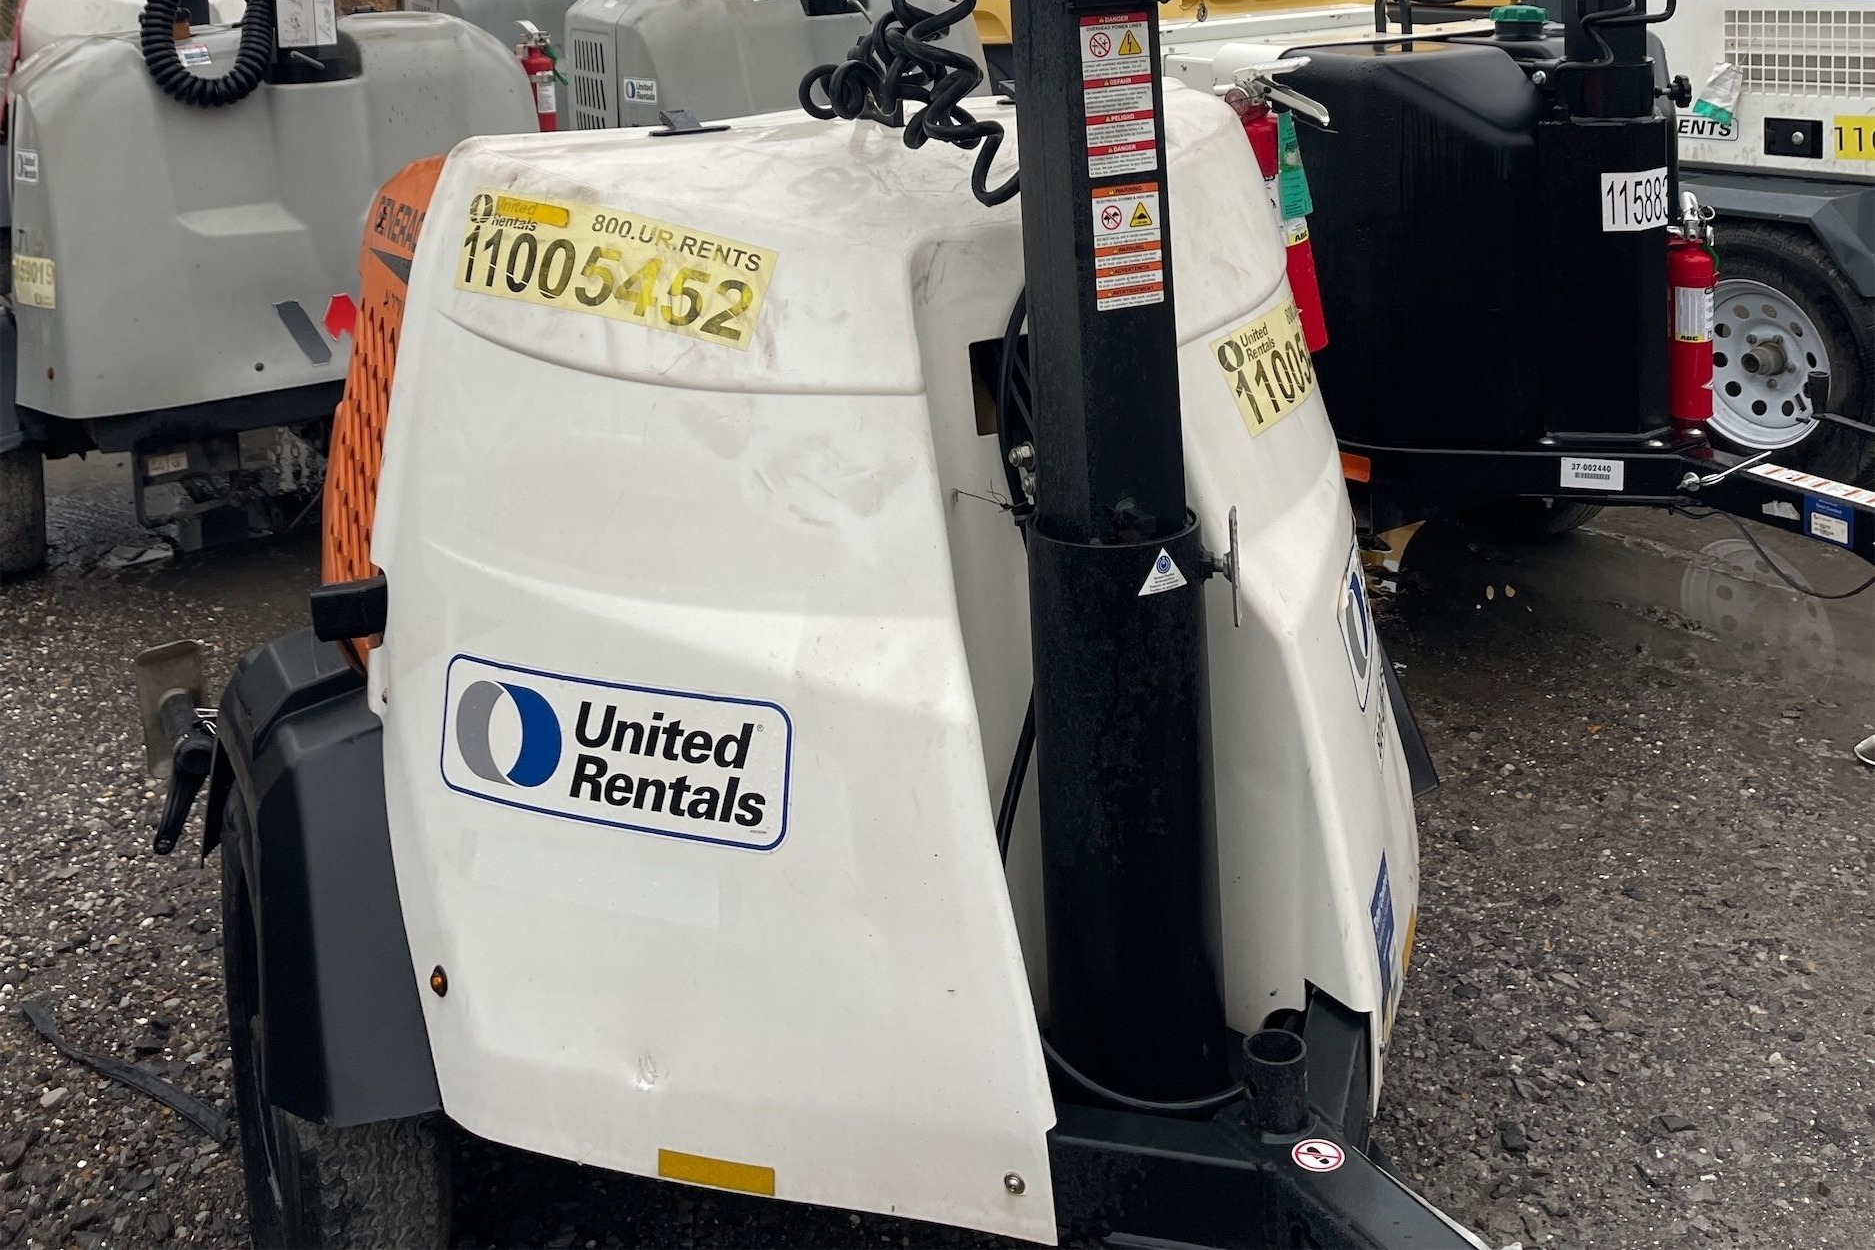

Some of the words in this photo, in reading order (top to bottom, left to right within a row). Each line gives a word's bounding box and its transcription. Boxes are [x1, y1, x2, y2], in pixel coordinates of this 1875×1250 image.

[1104, 15, 1129, 23] DANGER
[1109, 78, 1132, 86] GEFAHR
[1110, 113, 1135, 122] PELIGRO
[1113, 143, 1137, 152] DANGER
[1834, 126, 1875, 152] 11
[592, 214, 762, 271] 800.UR.RENTS
[464, 225, 753, 341] 11005452
[1240, 323, 1268, 347] United
[1246, 337, 1275, 362] Rentals
[1236, 332, 1312, 424] 11005
[574, 701, 755, 770] United
[569, 753, 766, 827] Rentals
